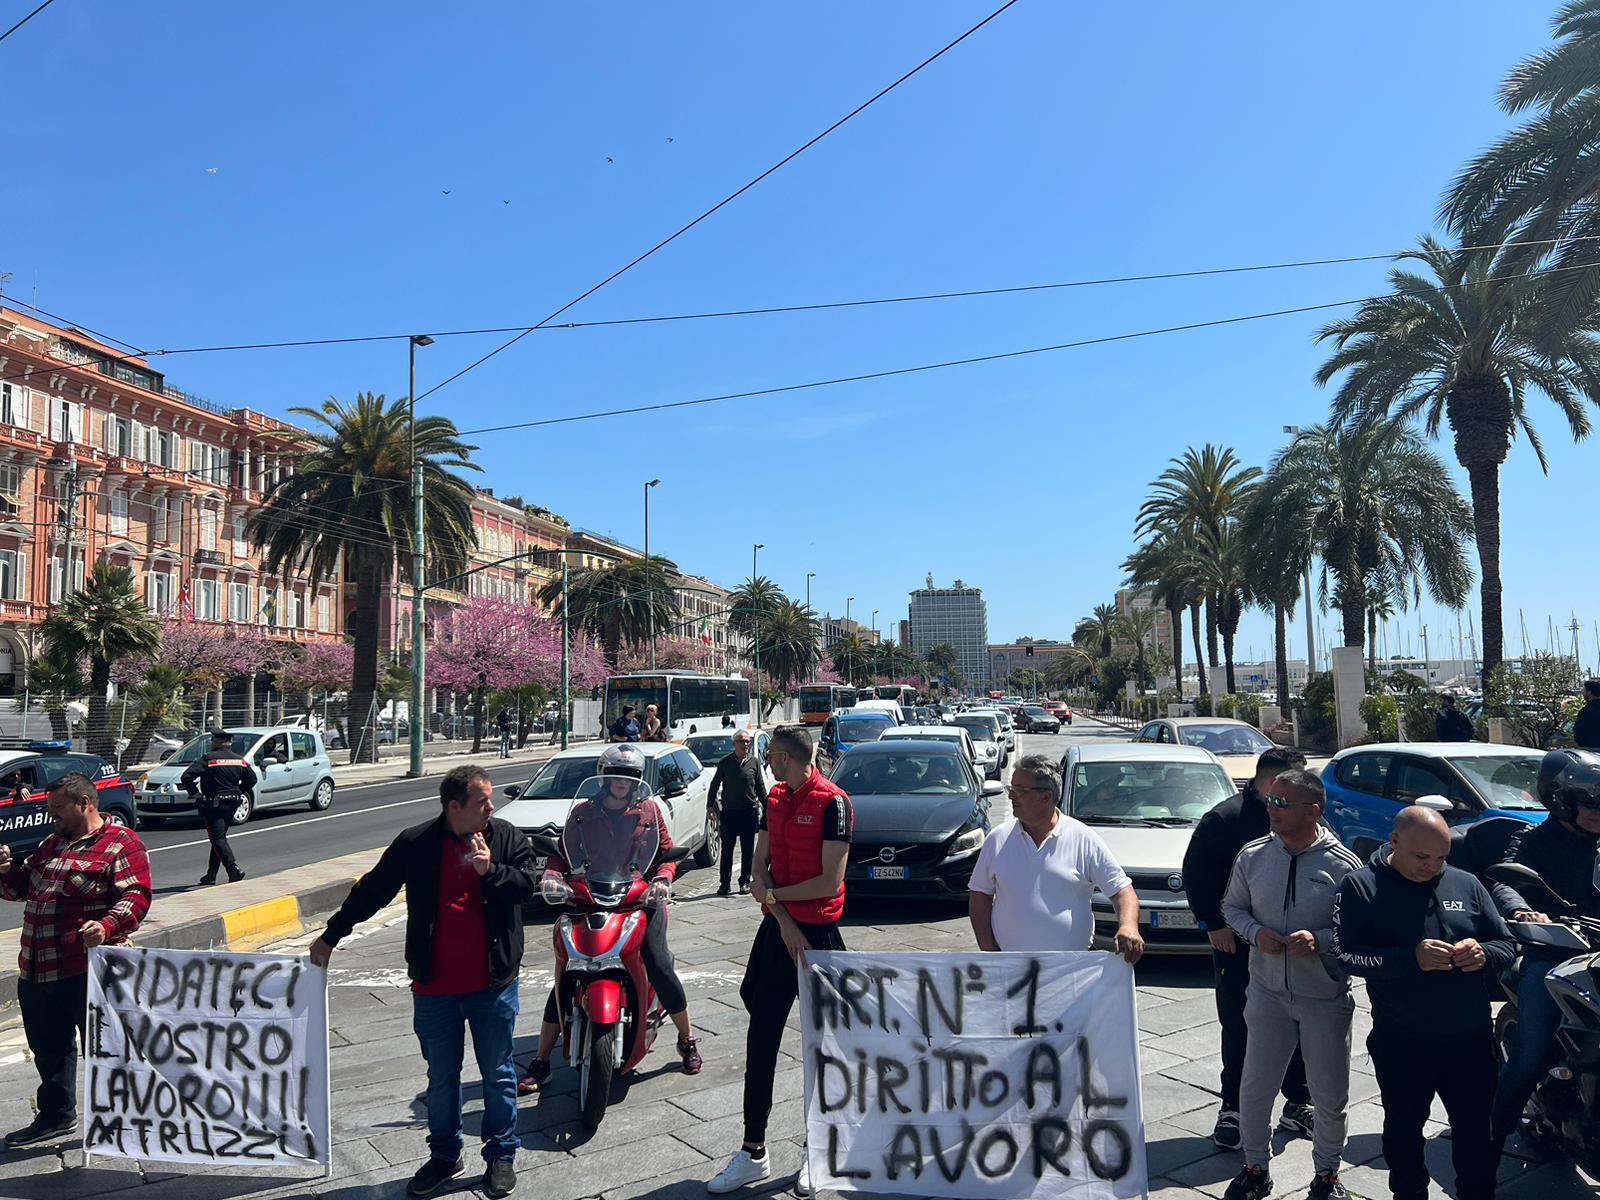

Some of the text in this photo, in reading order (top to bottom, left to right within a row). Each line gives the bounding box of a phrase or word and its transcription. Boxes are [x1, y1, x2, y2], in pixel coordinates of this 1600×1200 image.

[100, 764, 116, 776] 112
[1442, 900, 1463, 910] EA7
[1349, 954, 1383, 967] ARMANI
[811, 966, 900, 1034] ART.
[119, 1012, 293, 1070] NOSTRO
[1023, 1036, 1128, 1112] AL
[828, 1116, 1133, 1183] LAVORO
